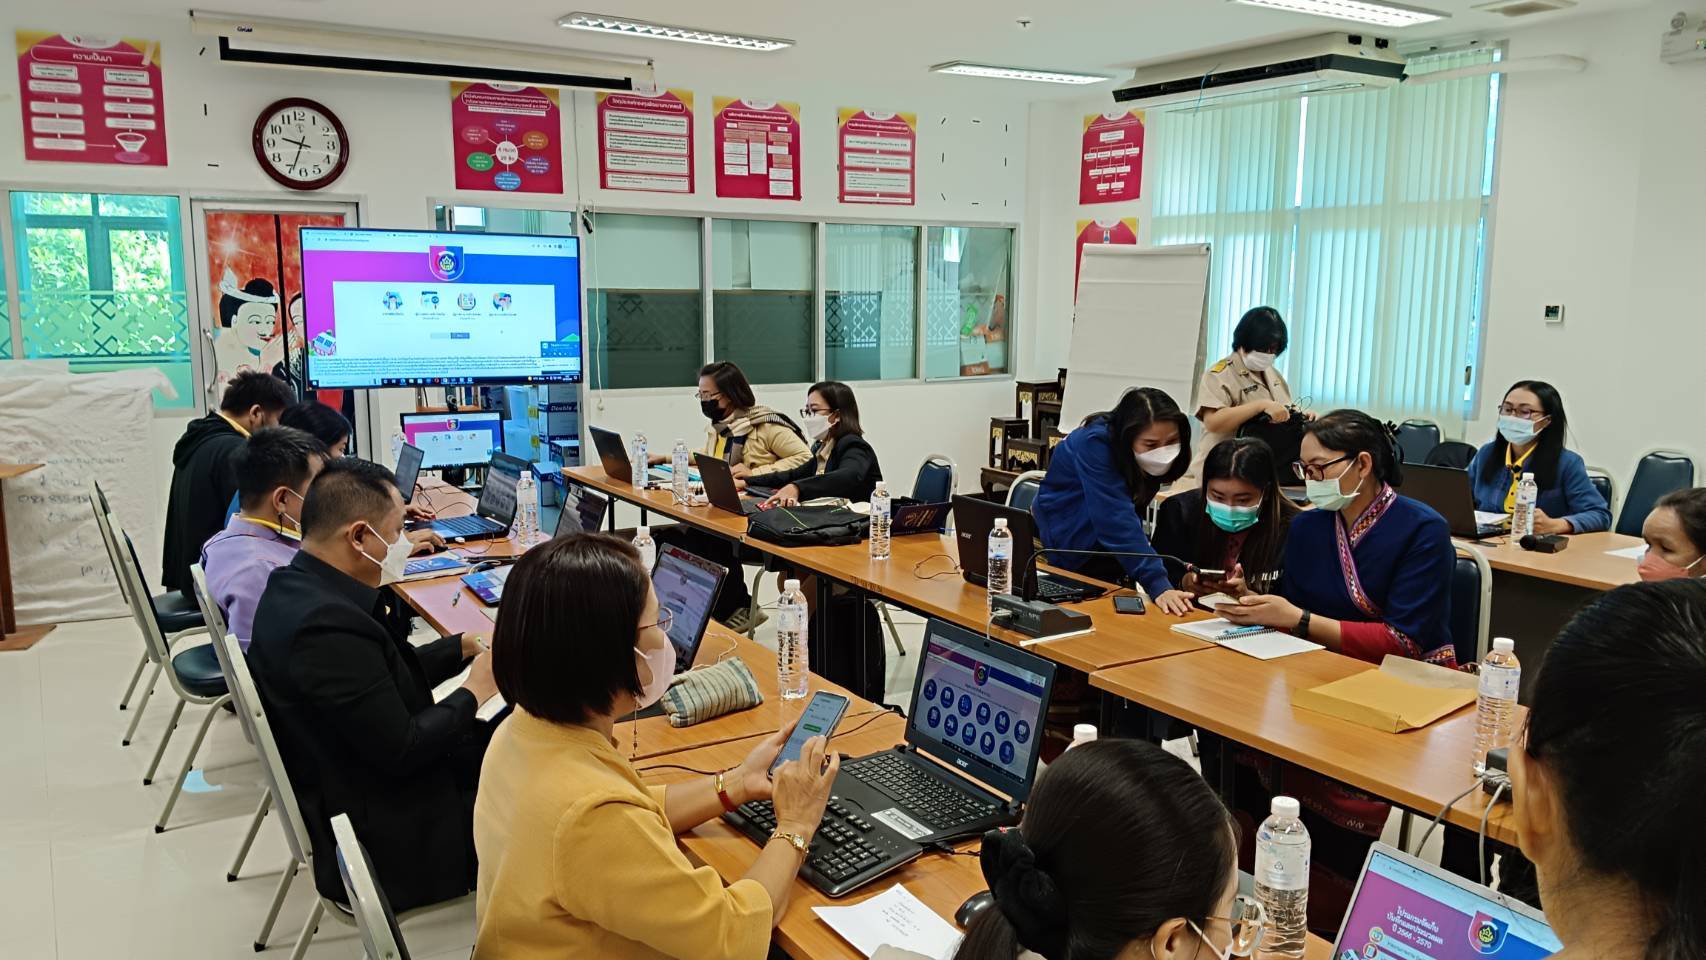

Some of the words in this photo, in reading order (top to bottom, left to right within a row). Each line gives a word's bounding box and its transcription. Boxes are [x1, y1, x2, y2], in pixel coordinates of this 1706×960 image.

[72, 52, 112, 62] ความเป็นมา
[282, 114, 290, 125] 11
[293, 111, 305, 121] 12
[312, 115, 316, 126] 1
[271, 124, 282, 135] 10
[322, 127, 330, 137] 2
[266, 138, 276, 148] 9
[327, 141, 336, 151] 3
[272, 153, 281, 163] 8
[323, 154, 331, 165] 4
[285, 164, 294, 174] 7
[299, 168, 308, 177] 6
[312, 164, 322, 175] 5
[956, 757, 969, 768] acer
[1416, 936, 1432, 949] 2570
